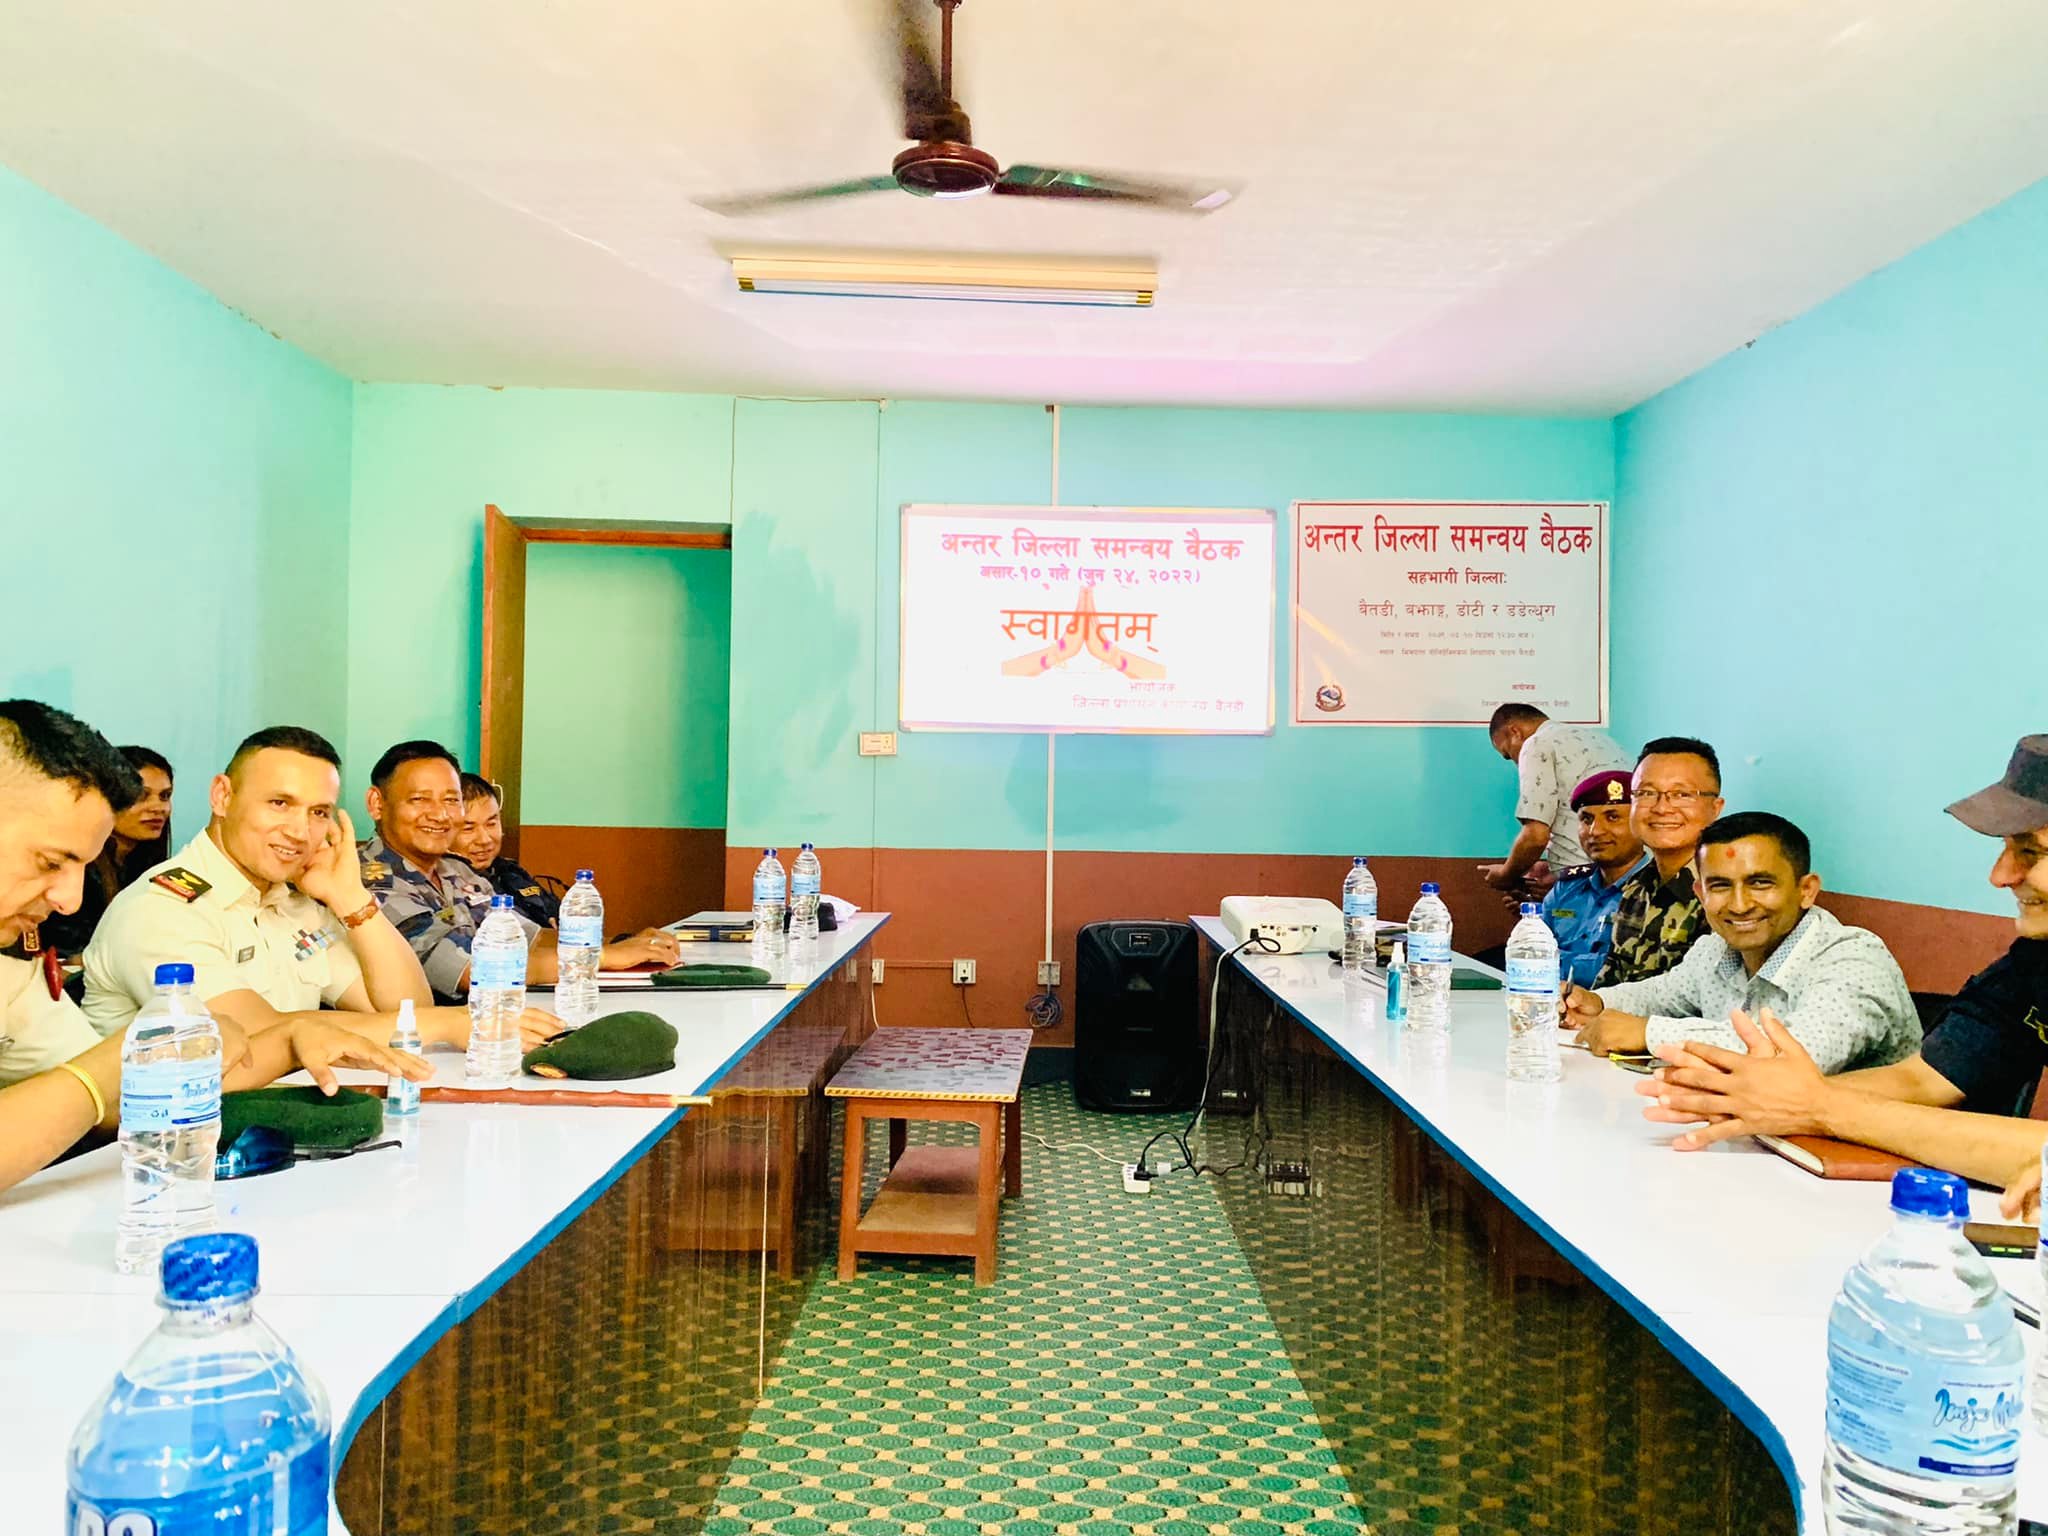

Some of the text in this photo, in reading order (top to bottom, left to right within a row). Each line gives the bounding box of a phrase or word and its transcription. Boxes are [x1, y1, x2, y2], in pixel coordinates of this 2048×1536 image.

[942, 528, 1245, 561] अन्तर जिल्ला समन्वय बैठक
[1304, 512, 1593, 554] अन्तर जिल्ला समन्वय बैठक
[1048, 563, 1071, 581] गते
[1077, 566, 1105, 587] (जुन
[1149, 569, 1200, 584] २०२२)
[1407, 567, 1459, 585] सहभागी
[1456, 599, 1484, 617] डोटी
[1491, 603, 1500, 617] र
[1000, 607, 1159, 653] स्वागतम्
